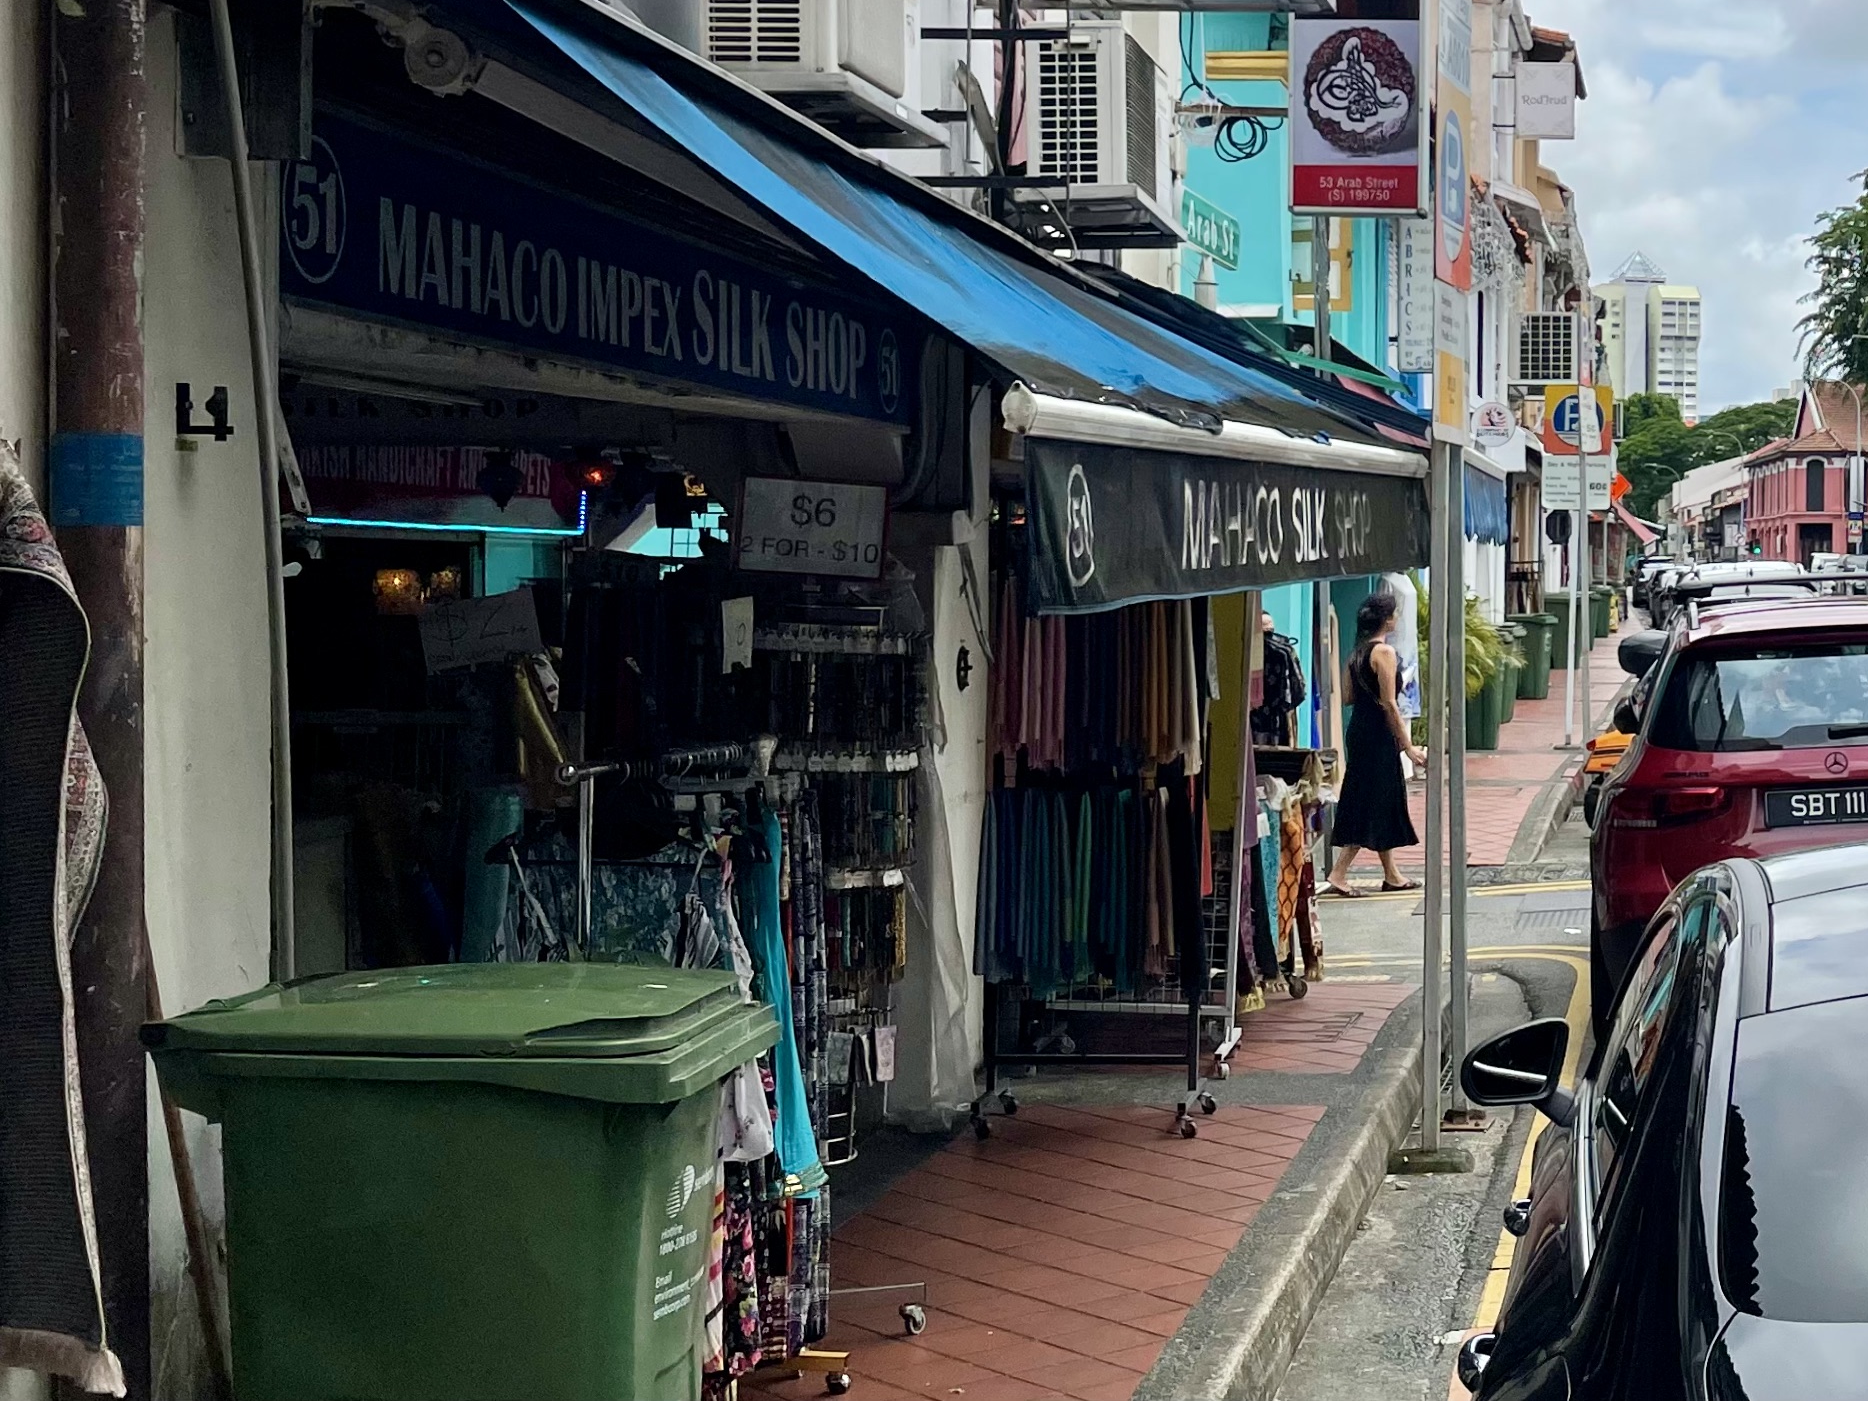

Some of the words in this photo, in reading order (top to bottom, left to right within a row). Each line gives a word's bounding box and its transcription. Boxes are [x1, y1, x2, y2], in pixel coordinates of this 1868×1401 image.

[292, 165, 337, 255] 51
[1319, 177, 1334, 189] 53
[1336, 177, 1362, 189] Arab
[1365, 177, 1399, 189] Street
[1328, 189, 1345, 202] (S)
[1349, 189, 1390, 201] 199750
[1186, 198, 1219, 251] Arab
[1221, 219, 1235, 260] St
[378, 195, 568, 335] MAHACO
[577, 256, 684, 362] IMPEX
[692, 269, 775, 382] SILK
[786, 301, 866, 399] SHOP
[1405, 228, 1413, 336] ABRICS
[789, 493, 837, 529] $6
[1181, 478, 1284, 570] MAHACO
[1292, 486, 1328, 563] SILK
[740, 537, 754, 555] 2
[761, 538, 810, 558] FOR
[830, 540, 879, 565] $10
